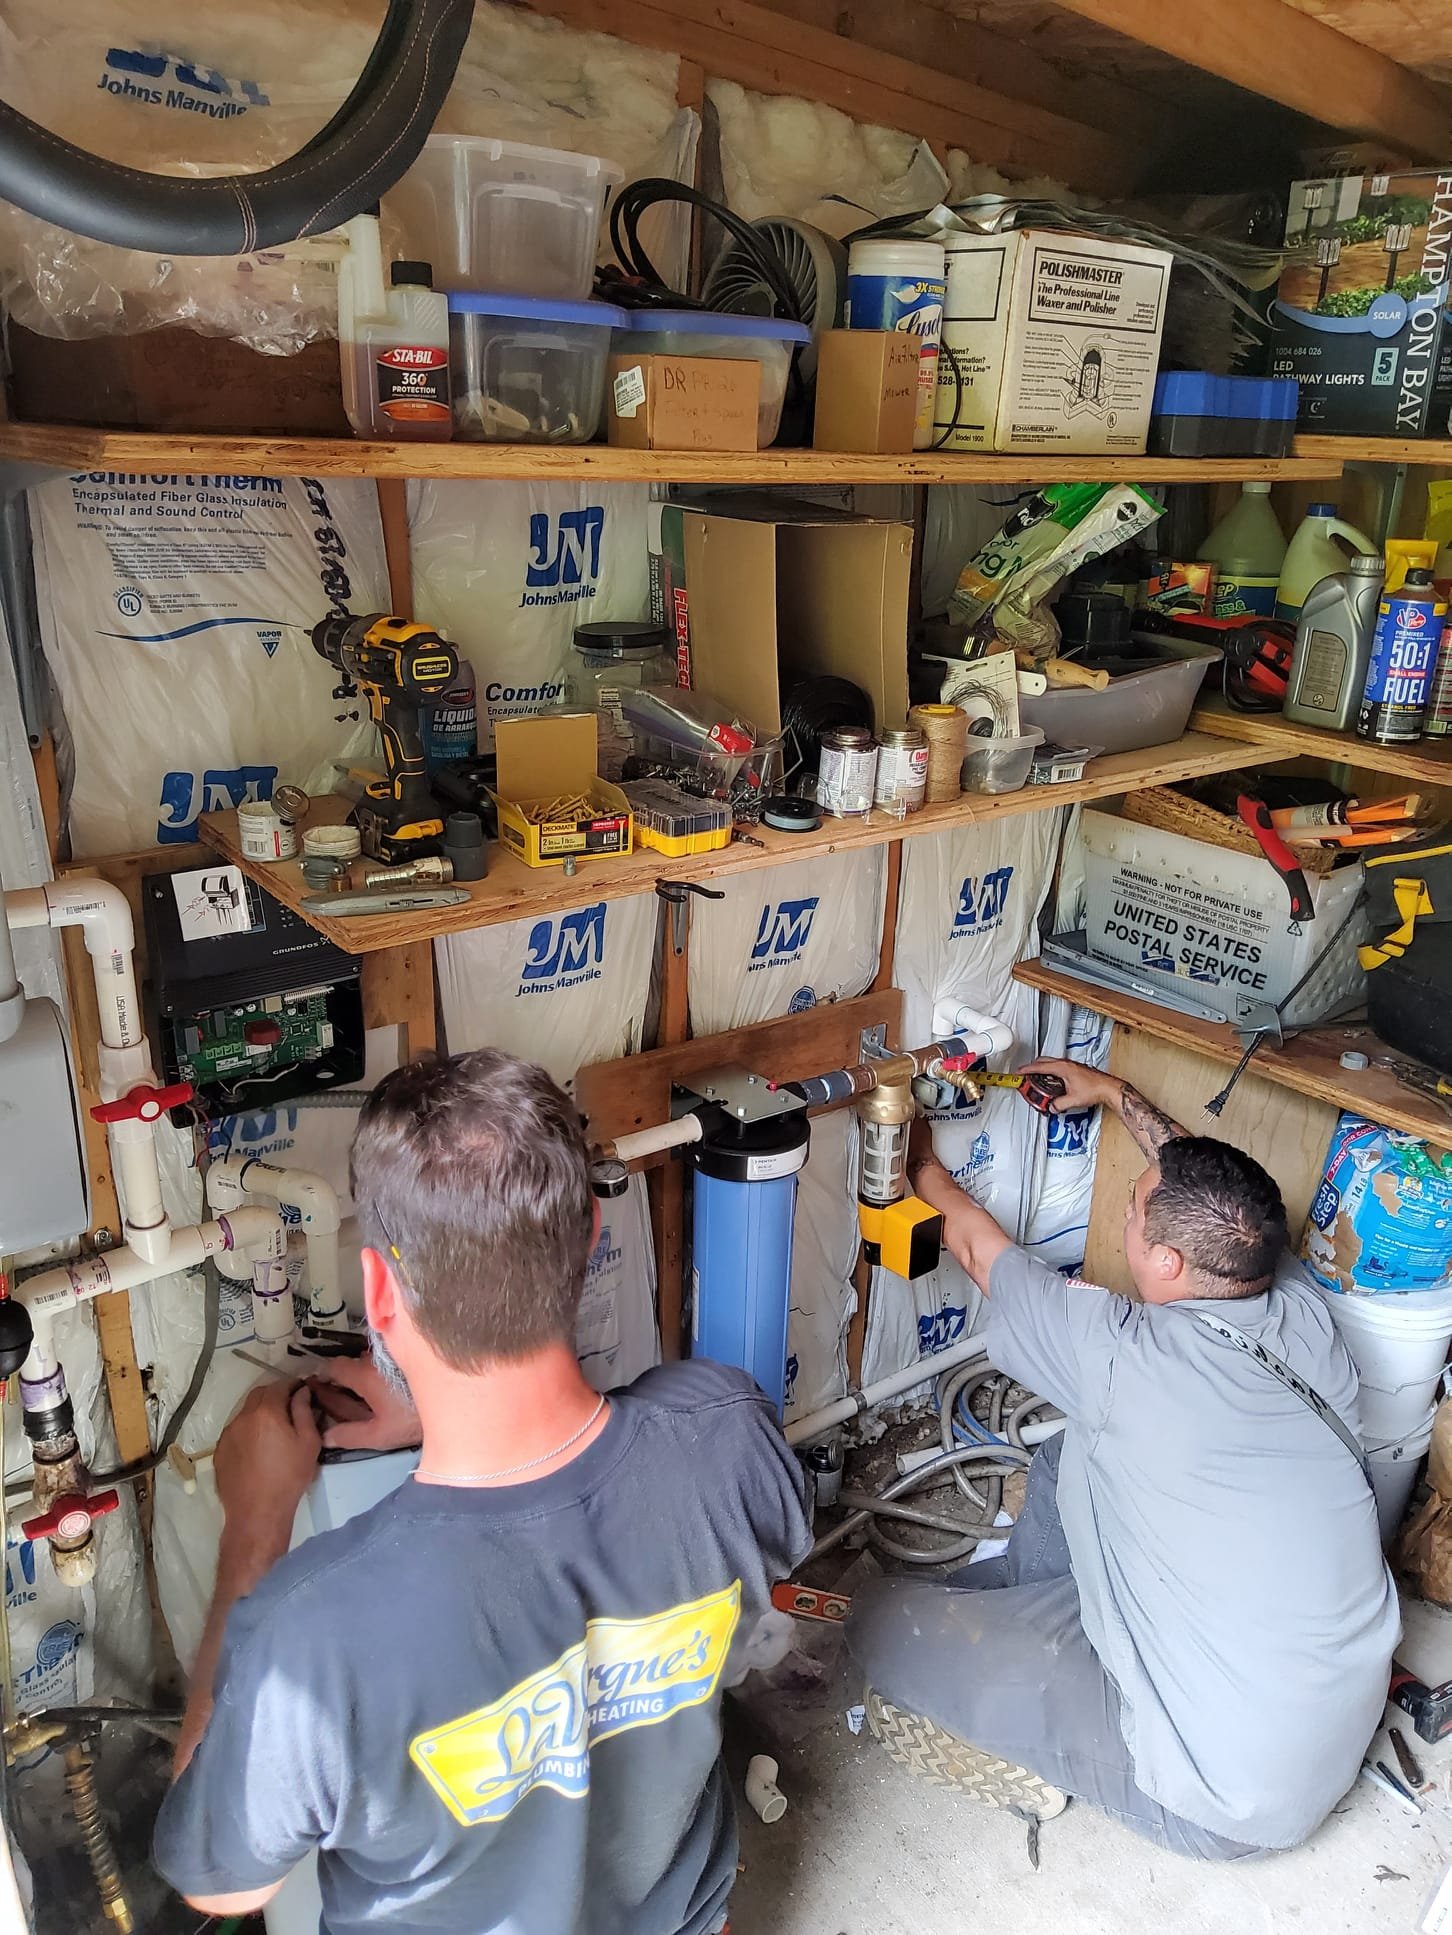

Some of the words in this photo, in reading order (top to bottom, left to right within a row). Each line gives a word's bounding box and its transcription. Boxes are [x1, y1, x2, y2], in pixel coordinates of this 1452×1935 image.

[97, 73, 163, 105] Johns
[1038, 260, 1123, 285] POLISHMASTER
[1407, 175, 1452, 358] HAMPTON
[1037, 281, 1053, 294] The
[1053, 284, 1104, 300] Professional
[1104, 289, 1120, 302] Line
[1036, 295, 1065, 309] Waxer
[1066, 300, 1083, 311] and
[1083, 301, 1117, 315] Polisher
[1372, 311, 1401, 320] SOLAR
[1273, 361, 1294, 371] LED
[1378, 352, 1392, 375] 5
[664, 367, 687, 393] DR
[937, 376, 974, 386] 528-131
[1325, 374, 1365, 385] LIGHTS
[1375, 375, 1391, 383] PACK
[392, 386, 436, 394] PROTECTION
[1396, 367, 1428, 431] BAY
[1012, 424, 1055, 433] CHAMBERLAIN
[72, 488, 156, 503] Encapsulated
[160, 491, 192, 502] Fiber
[196, 492, 228, 505] Glass
[231, 496, 287, 510] Insulation
[75, 502, 125, 516] Thermal
[129, 506, 153, 516] and
[156, 506, 196, 517] Sound
[200, 507, 244, 520] Control
[113, 585, 144, 599] CLASSIFIED
[519, 592, 558, 608] Johns
[123, 598, 137, 612] UL
[256, 630, 282, 638] VAPOR
[1389, 640, 1431, 669] 50:1
[1383, 677, 1425, 704] FUEL
[542, 823, 576, 832] DECKMATE
[1120, 867, 1158, 887] WARNING
[1164, 882, 1183, 896] NOT
[1183, 888, 1202, 902] FOR
[1203, 895, 1241, 914] PRIVATE
[1243, 907, 1263, 920] USE
[1162, 902, 1179, 913] YEARS
[1166, 896, 1182, 905] THEFT
[1218, 913, 1239, 925] POSTAL
[1239, 920, 1270, 934] PROPERTY
[522, 902, 608, 980] JM
[948, 928, 976, 941] Johns
[1113, 899, 1179, 935] UNITED
[1182, 925, 1262, 964] STATES
[272, 942, 319, 955] GRUNDFOS
[1104, 920, 1174, 958] POSTAL
[1179, 947, 1268, 990] SERVICE
[515, 982, 555, 998] Johns
[1311, 1182, 1330, 1221] Fresh
[1351, 1185, 1364, 1199] 14
[1316, 1192, 1340, 1228] Step
[587, 1698, 664, 1729] HEATING
